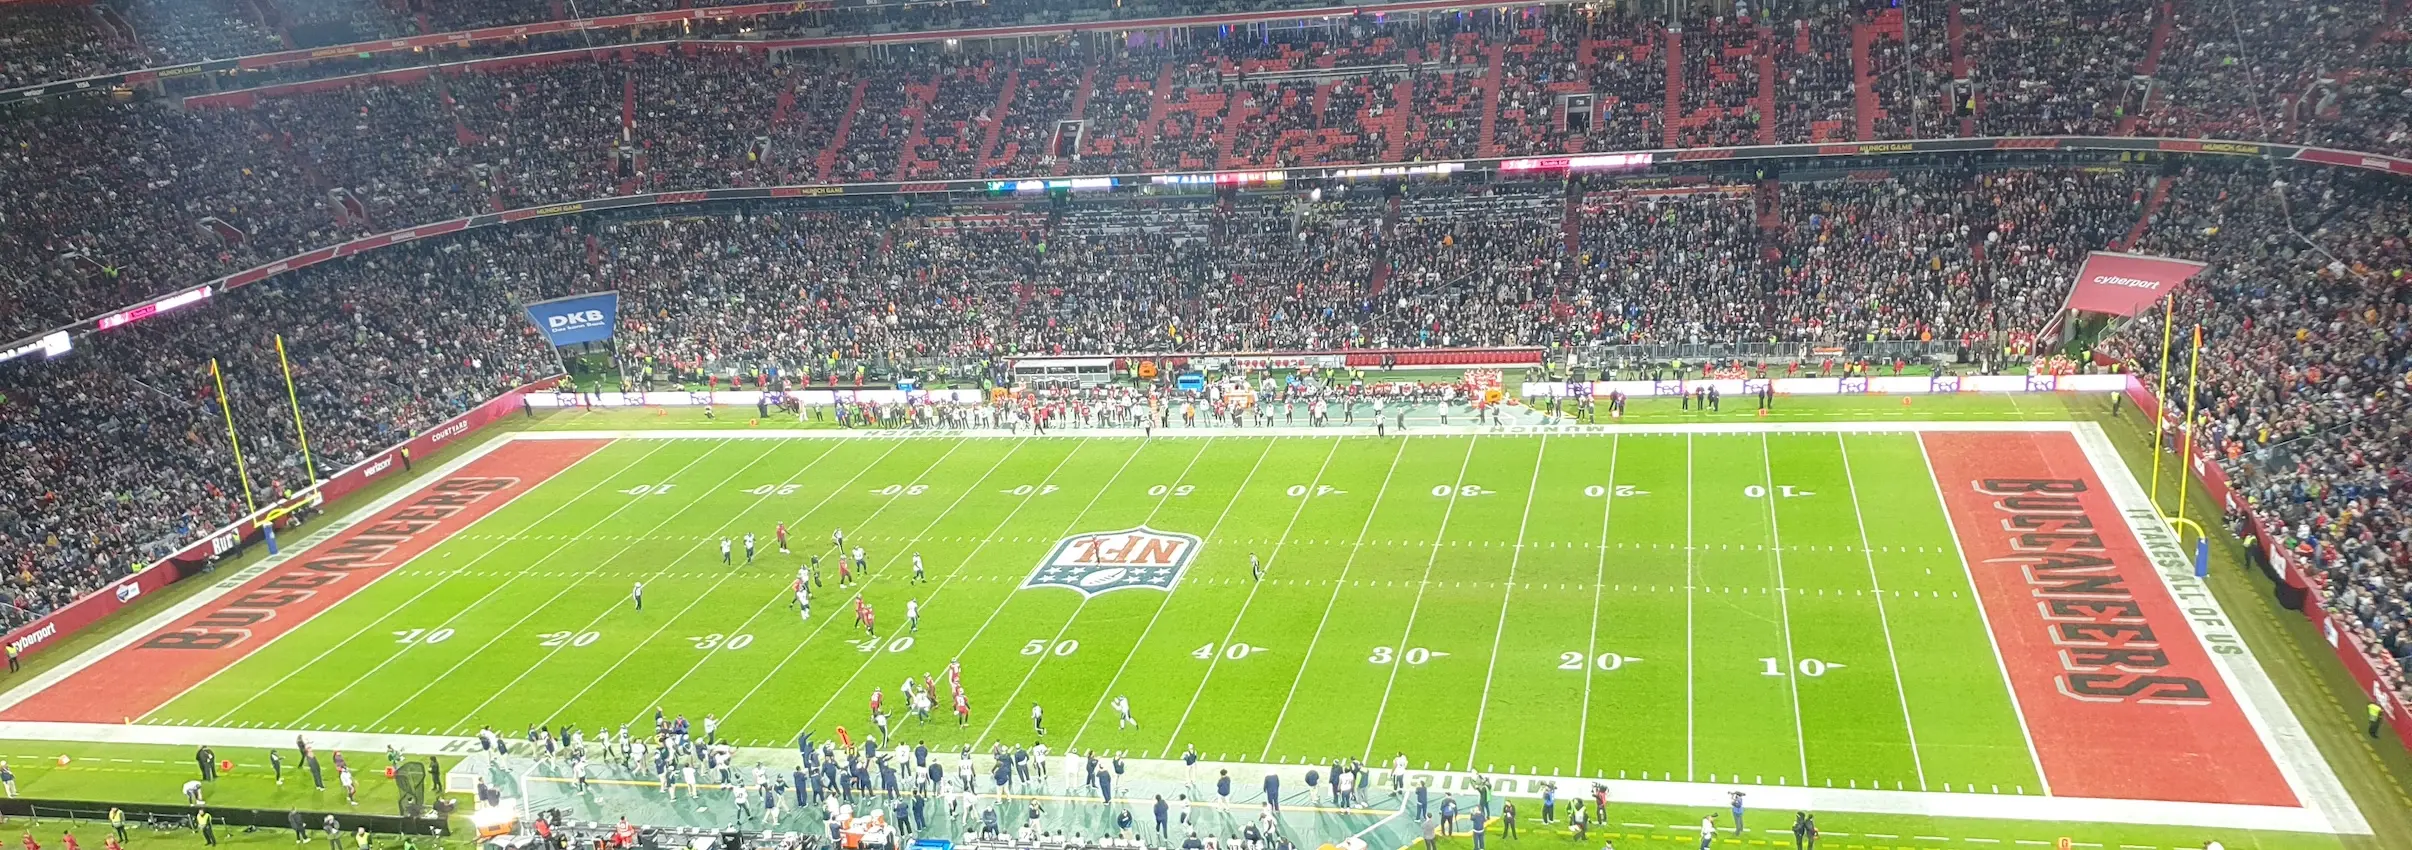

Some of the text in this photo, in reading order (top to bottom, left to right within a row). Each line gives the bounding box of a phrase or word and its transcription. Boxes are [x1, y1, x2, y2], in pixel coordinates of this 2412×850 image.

[1859, 144, 1889, 152] MUNICH
[2202, 143, 2234, 152] MUNICH
[2235, 145, 2259, 153] GAME
[802, 187, 825, 195] MUNICH
[536, 203, 582, 215] MUNICH GAME
[2093, 275, 2160, 290] cyberport
[548, 309, 605, 328] DKB
[432, 420, 469, 442] COURTYARD
[863, 429, 966, 438] MUNICH
[1490, 424, 1606, 434] MUNICH
[364, 454, 392, 477] verizon
[628, 484, 677, 496] 10
[752, 484, 803, 496] 20
[881, 484, 930, 496] 30
[1011, 484, 1061, 496] 40
[1147, 484, 1197, 497] 50
[1286, 484, 1336, 497] 40
[1431, 484, 1482, 497] 30
[1584, 484, 1637, 498] 20
[1744, 484, 1799, 498] 10
[1073, 535, 1185, 565] NFL
[2137, 519, 2186, 569] TAKES
[137, 476, 521, 651] BUCCANEERS
[1971, 478, 2212, 706] BUCCANEERS
[2165, 573, 2206, 600] ALL
[2188, 607, 2226, 627] OF
[395, 628, 455, 644] 10
[539, 630, 600, 647] 20
[694, 633, 754, 650] 30
[855, 636, 915, 653] 40
[2204, 634, 2245, 655] US
[1020, 639, 1080, 657] 50
[1191, 642, 1251, 660] 40
[1368, 646, 1430, 665] 30
[1557, 651, 1623, 671] 20
[1758, 657, 1826, 677] 10
